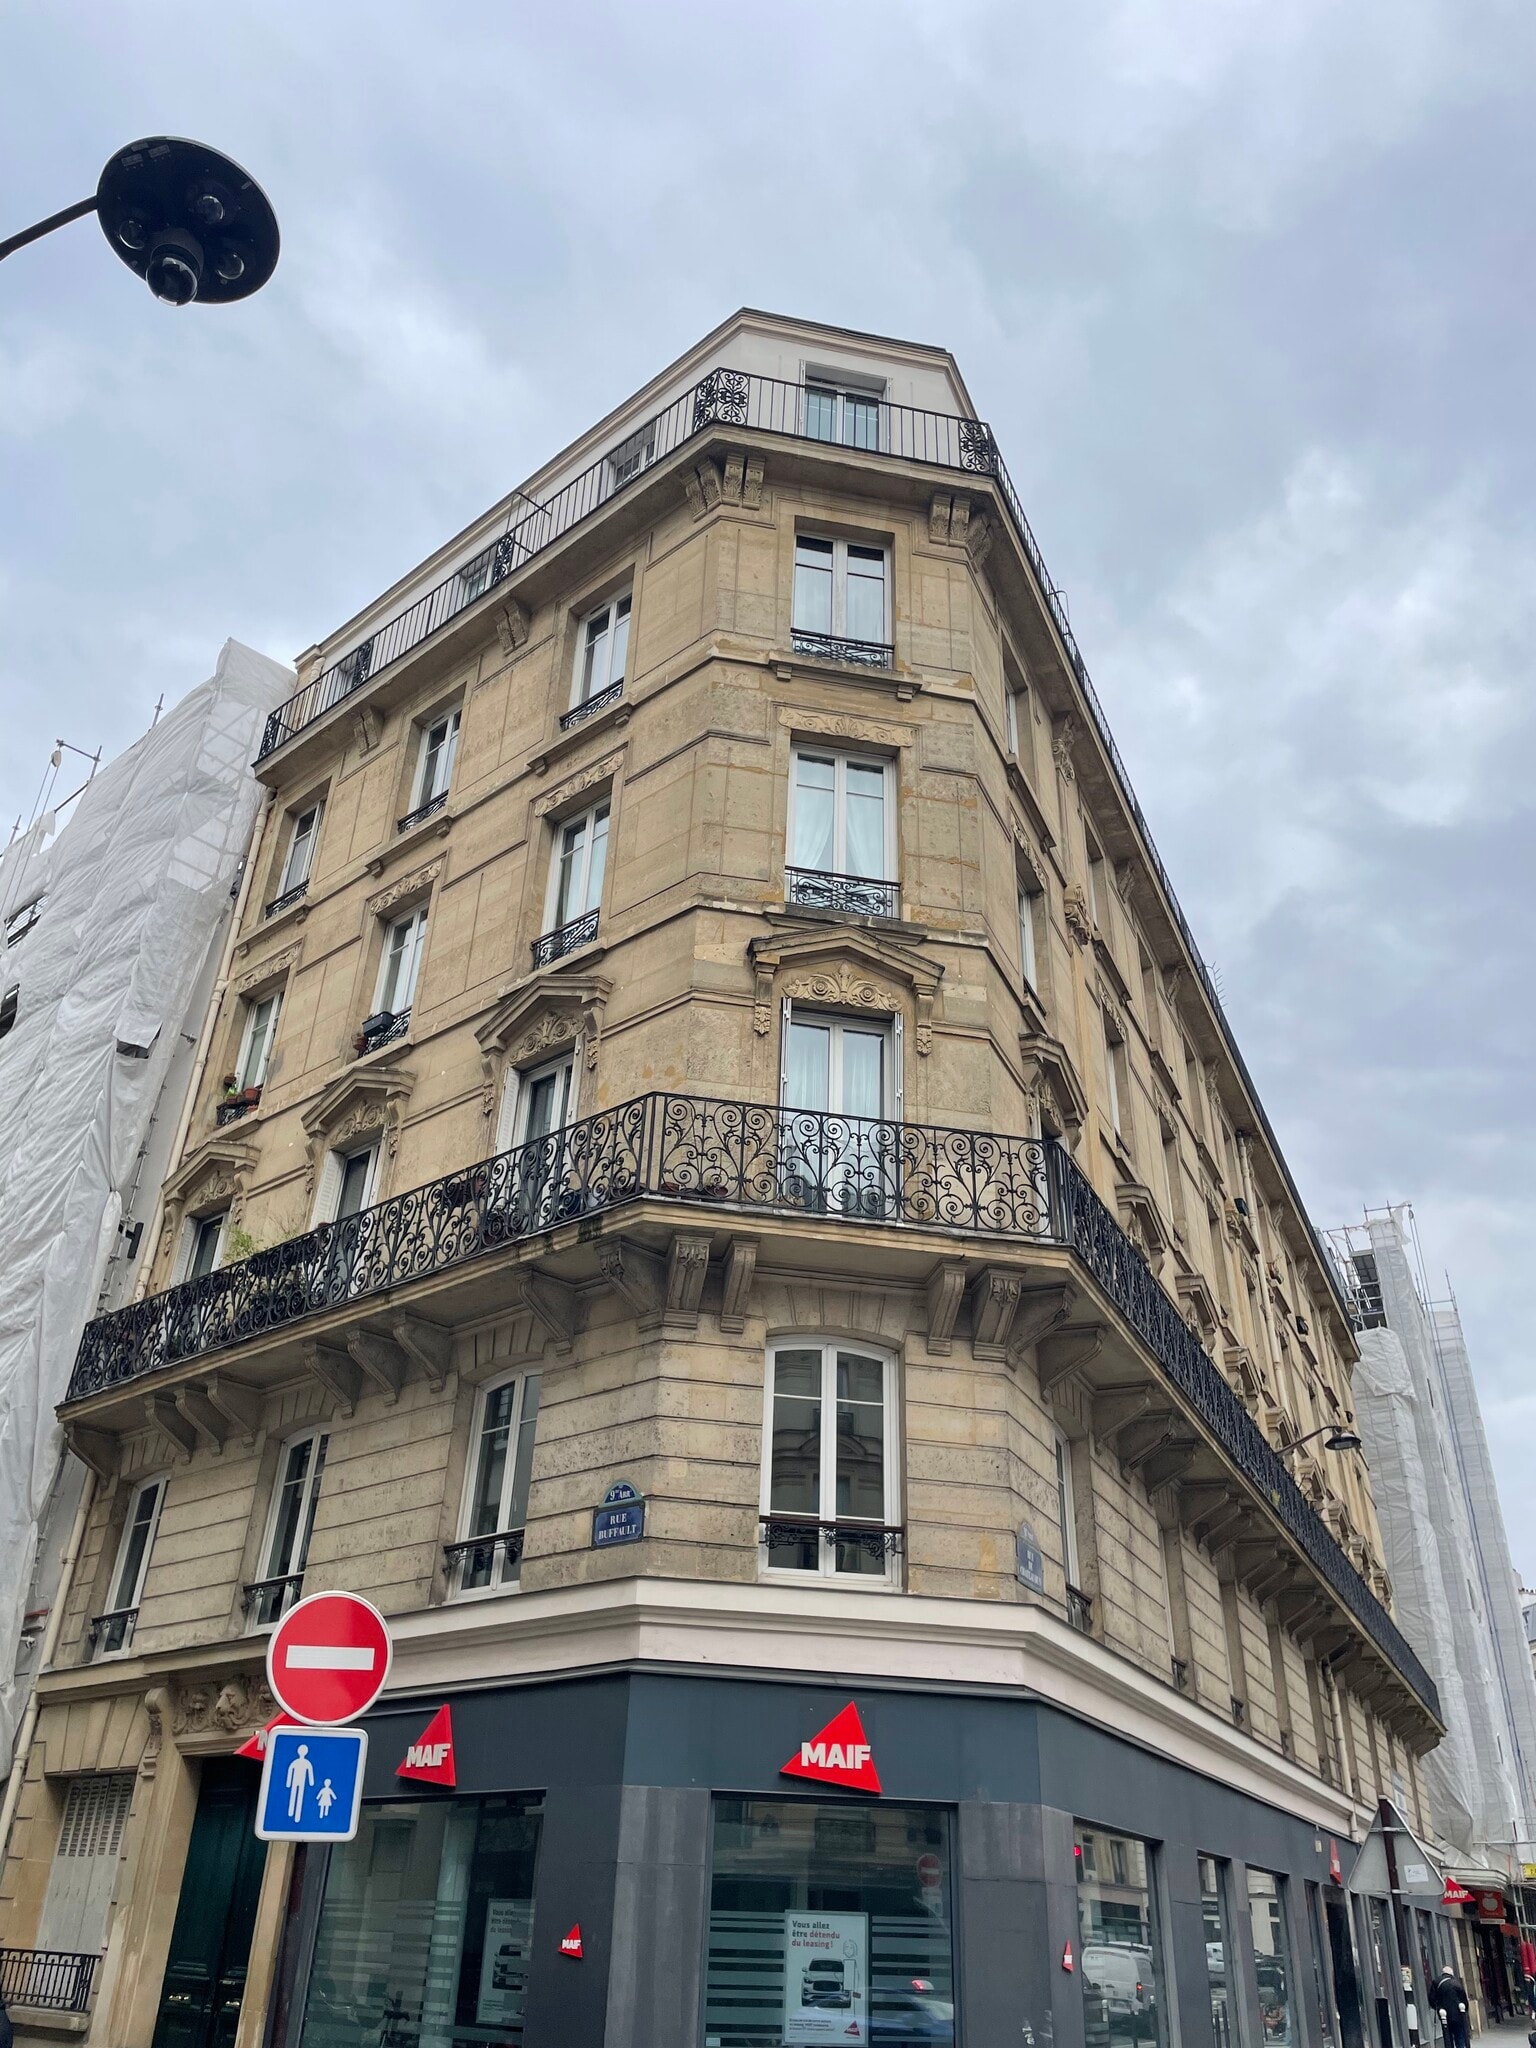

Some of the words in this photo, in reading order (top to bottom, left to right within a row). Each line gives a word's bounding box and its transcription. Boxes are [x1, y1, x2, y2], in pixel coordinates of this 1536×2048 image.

[610, 1513, 627, 1525] RUE
[598, 1524, 637, 1540] BUFFAULT
[406, 1743, 451, 1768] MAIF
[801, 1742, 871, 1769] MAIF
[1444, 1890, 1469, 1899] MAIF
[792, 1920, 810, 1928] Vous
[812, 1921, 830, 1929] allez
[792, 1929, 808, 1938] être
[809, 1930, 840, 1939] détendu
[791, 1939, 801, 1947] du
